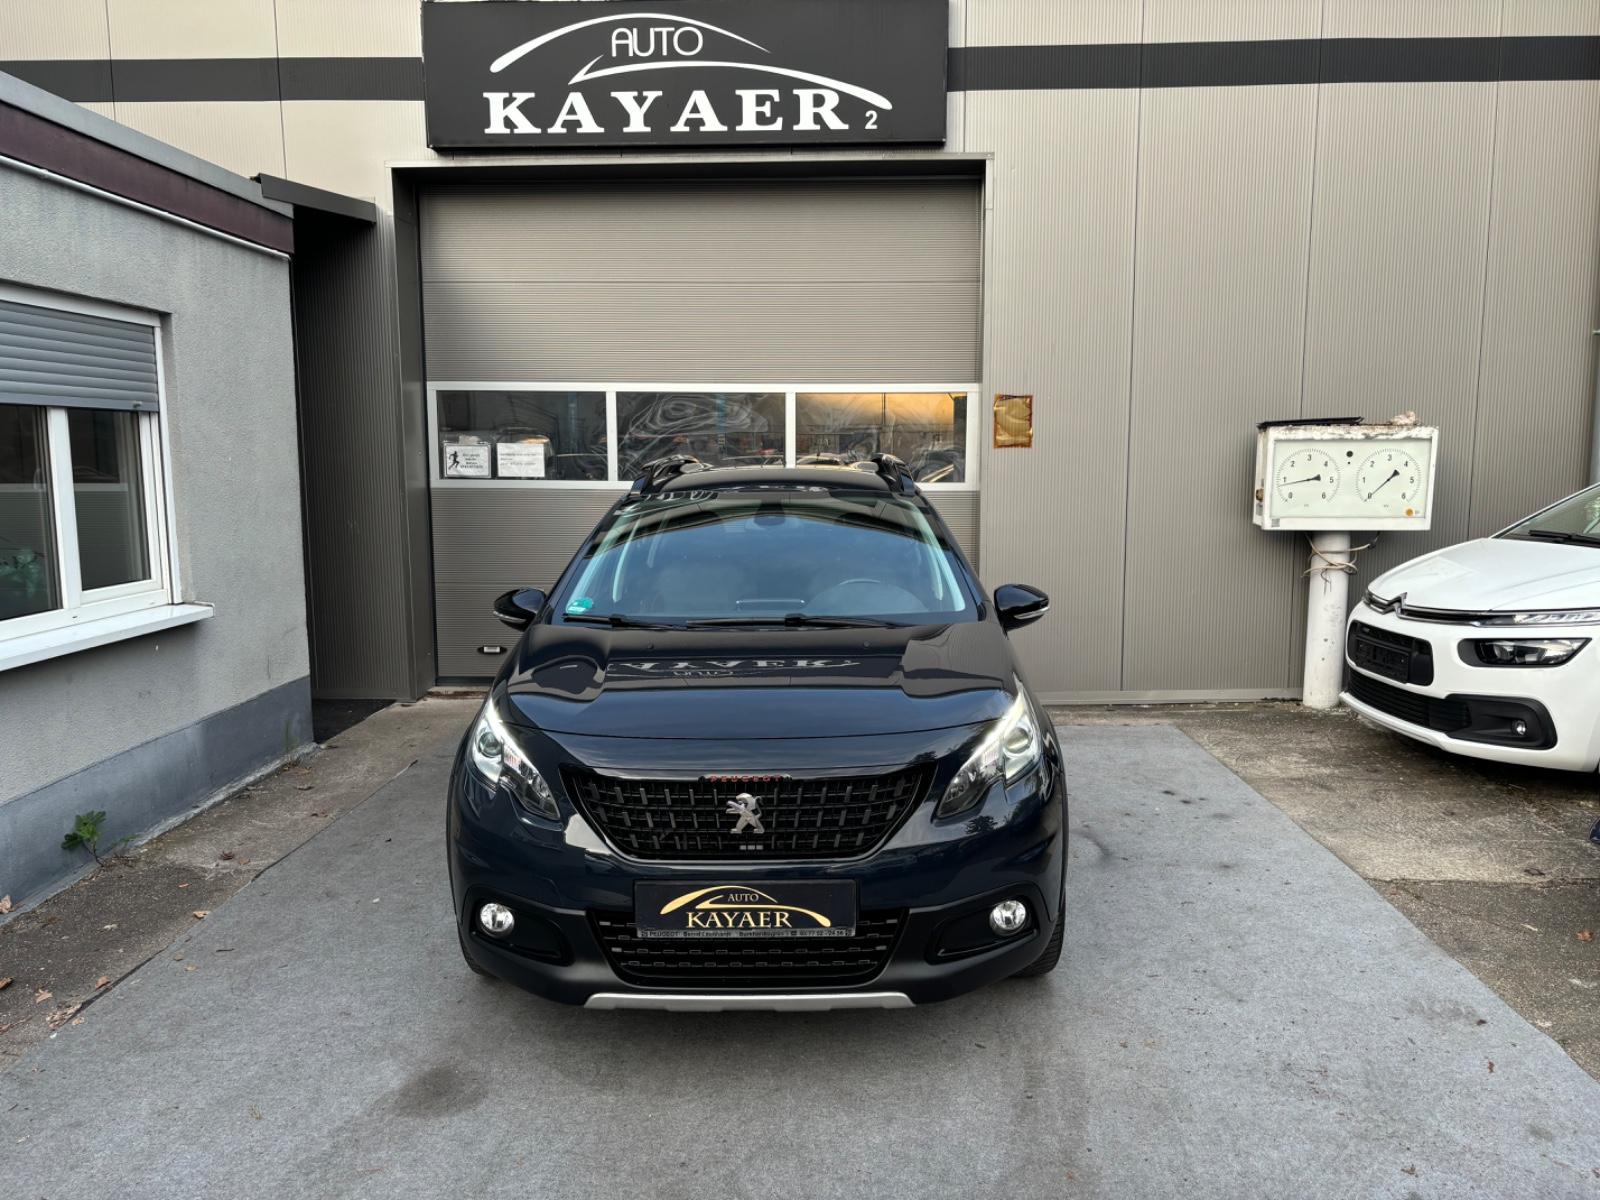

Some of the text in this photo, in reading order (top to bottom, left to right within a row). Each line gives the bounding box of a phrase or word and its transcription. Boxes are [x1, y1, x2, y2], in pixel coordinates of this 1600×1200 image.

[611, 26, 704, 57] AUTO
[482, 89, 878, 135] KAYAER 2
[709, 774, 782, 783] PEUGEOT
[727, 893, 760, 903] AUTO
[686, 911, 793, 929] KAYAER
